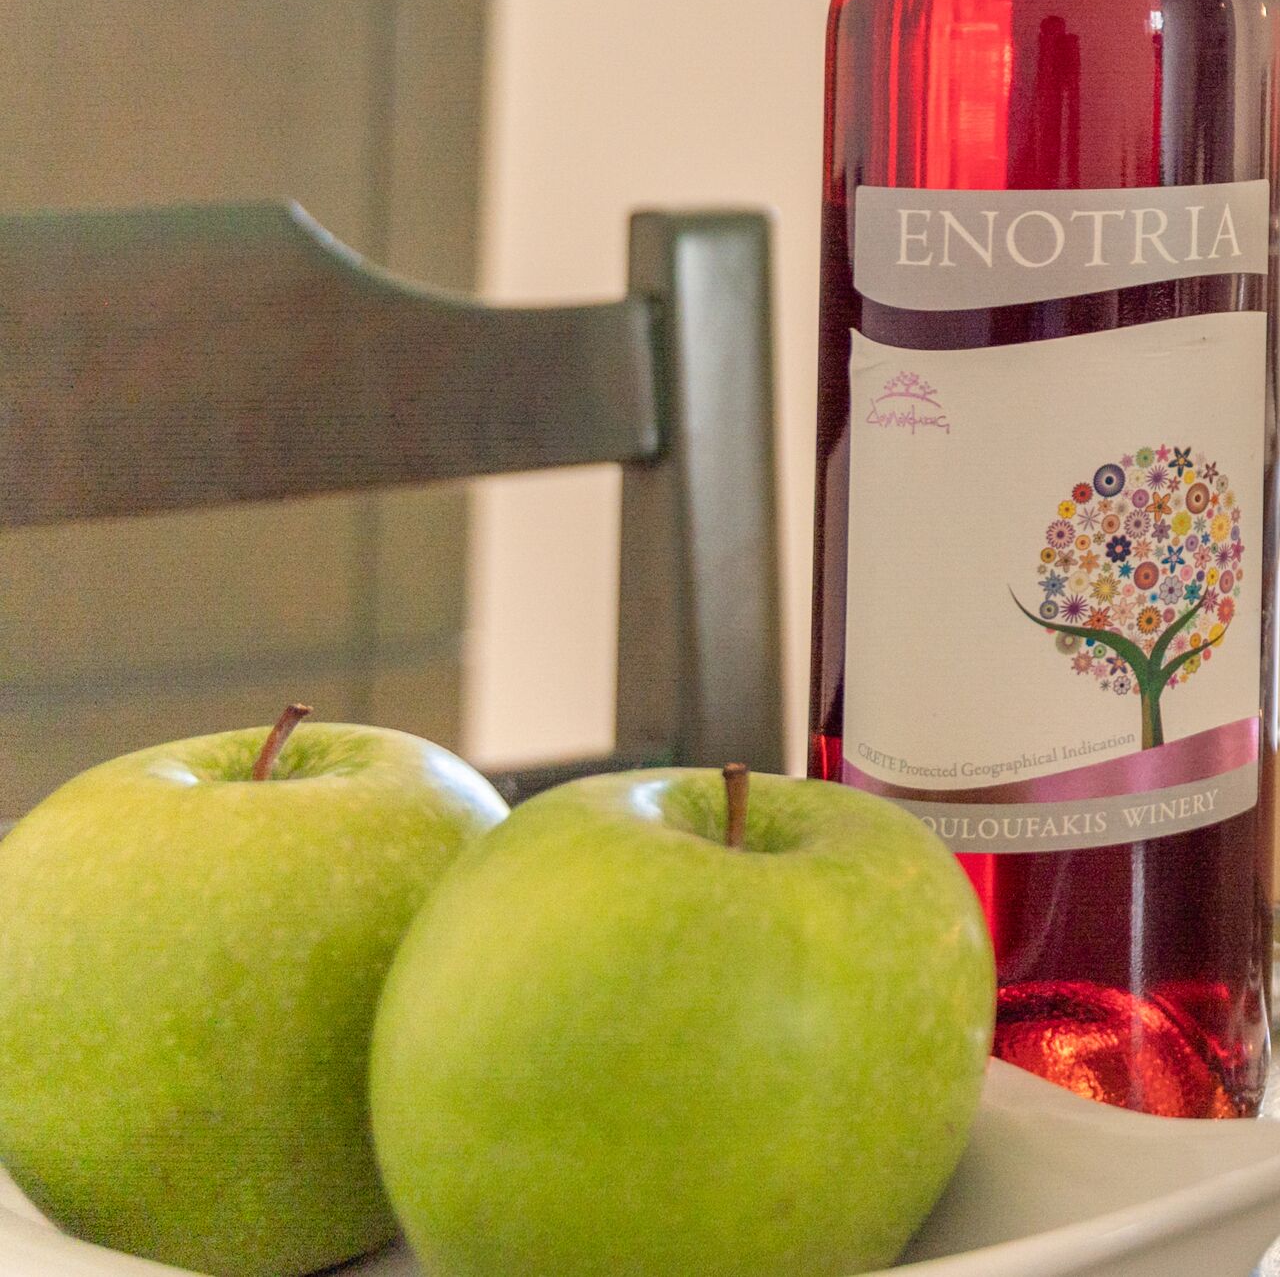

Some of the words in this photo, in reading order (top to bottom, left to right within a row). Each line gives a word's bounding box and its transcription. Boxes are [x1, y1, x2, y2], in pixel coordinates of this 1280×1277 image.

[895, 203, 1243, 268] ENOTRIA
[858, 742, 896, 771] CRETE
[899, 759, 957, 777] Protected
[961, 748, 1057, 778] Geographical
[1062, 733, 1136, 759] Indication
[1122, 789, 1218, 828] WINERY
